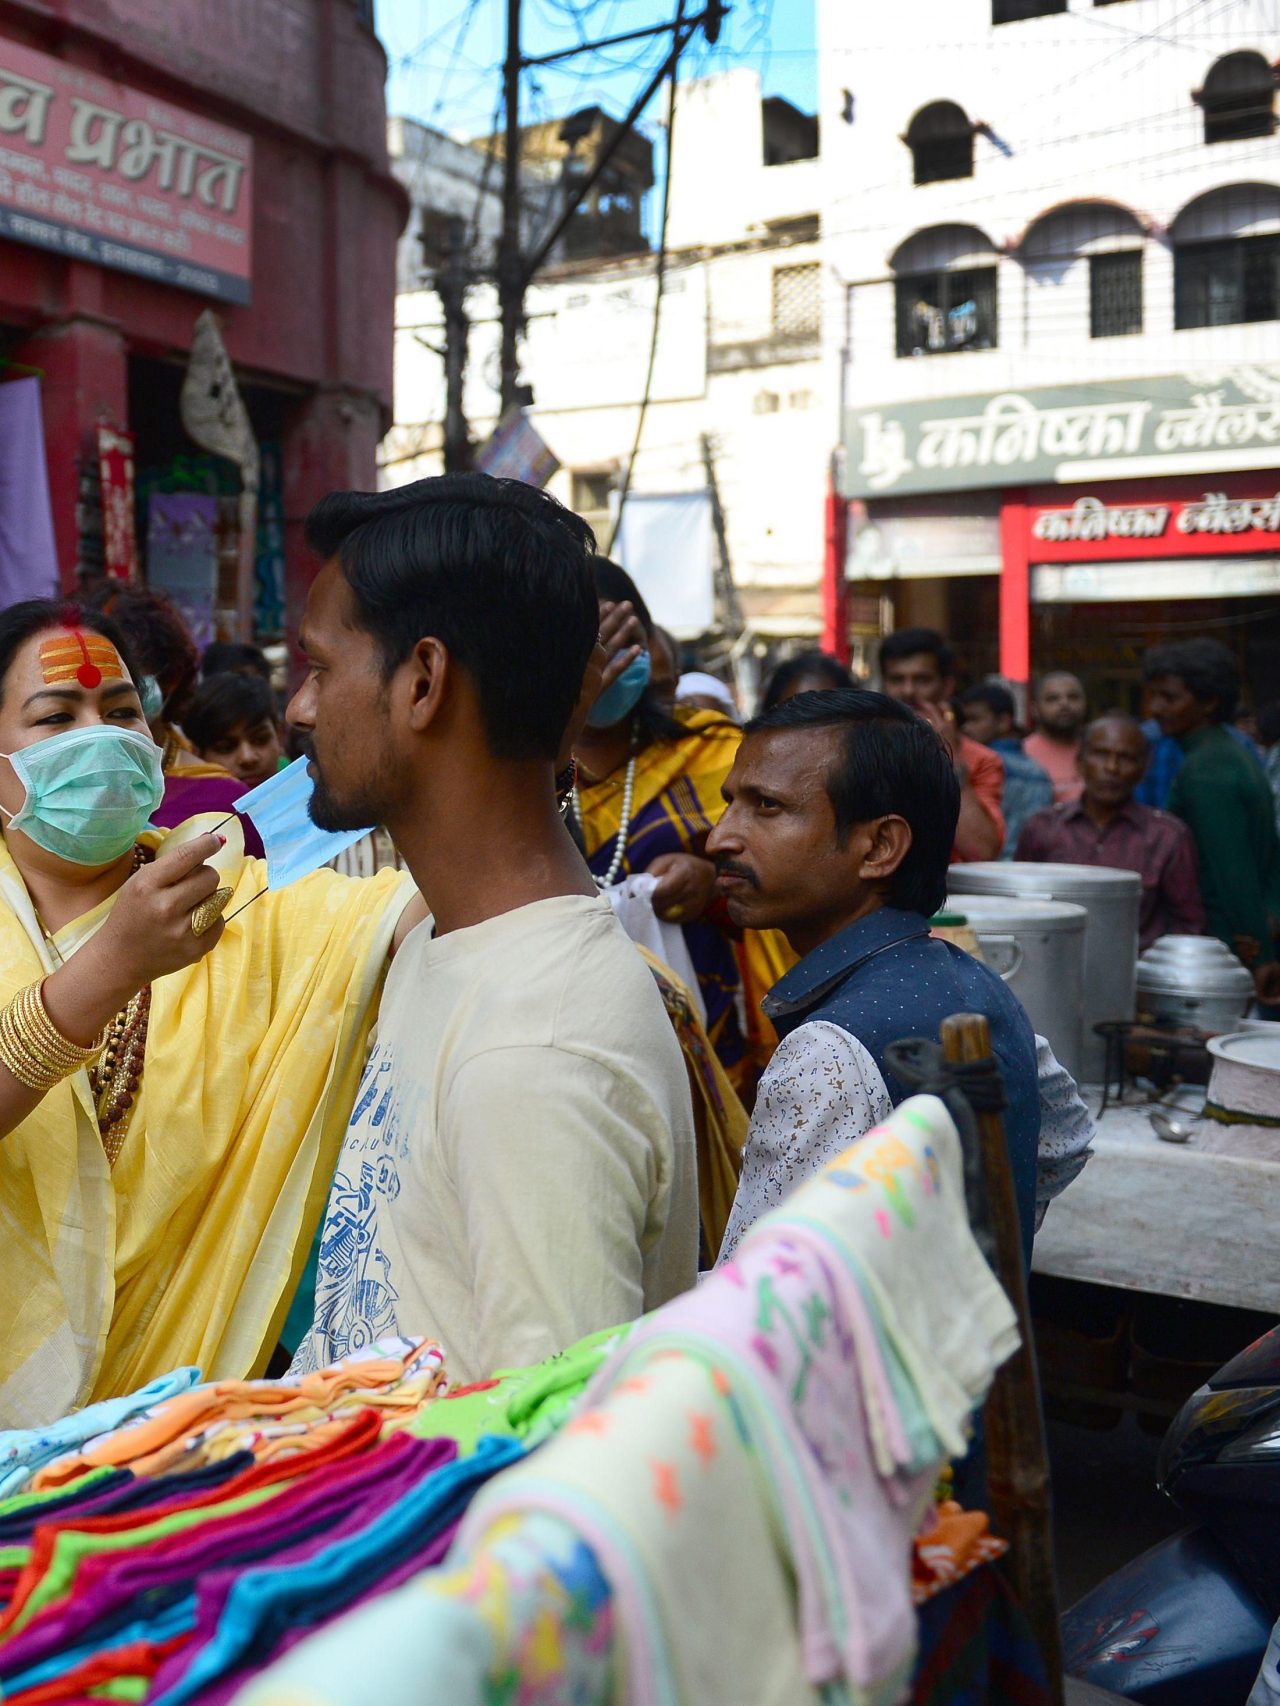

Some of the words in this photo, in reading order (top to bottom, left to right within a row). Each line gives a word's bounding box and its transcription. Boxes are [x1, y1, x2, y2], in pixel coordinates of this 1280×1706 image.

[64, 96, 245, 213] प्रभात
[916, 393, 1152, 469] कनिष्का
[1032, 497, 1169, 541] कनिष्का
